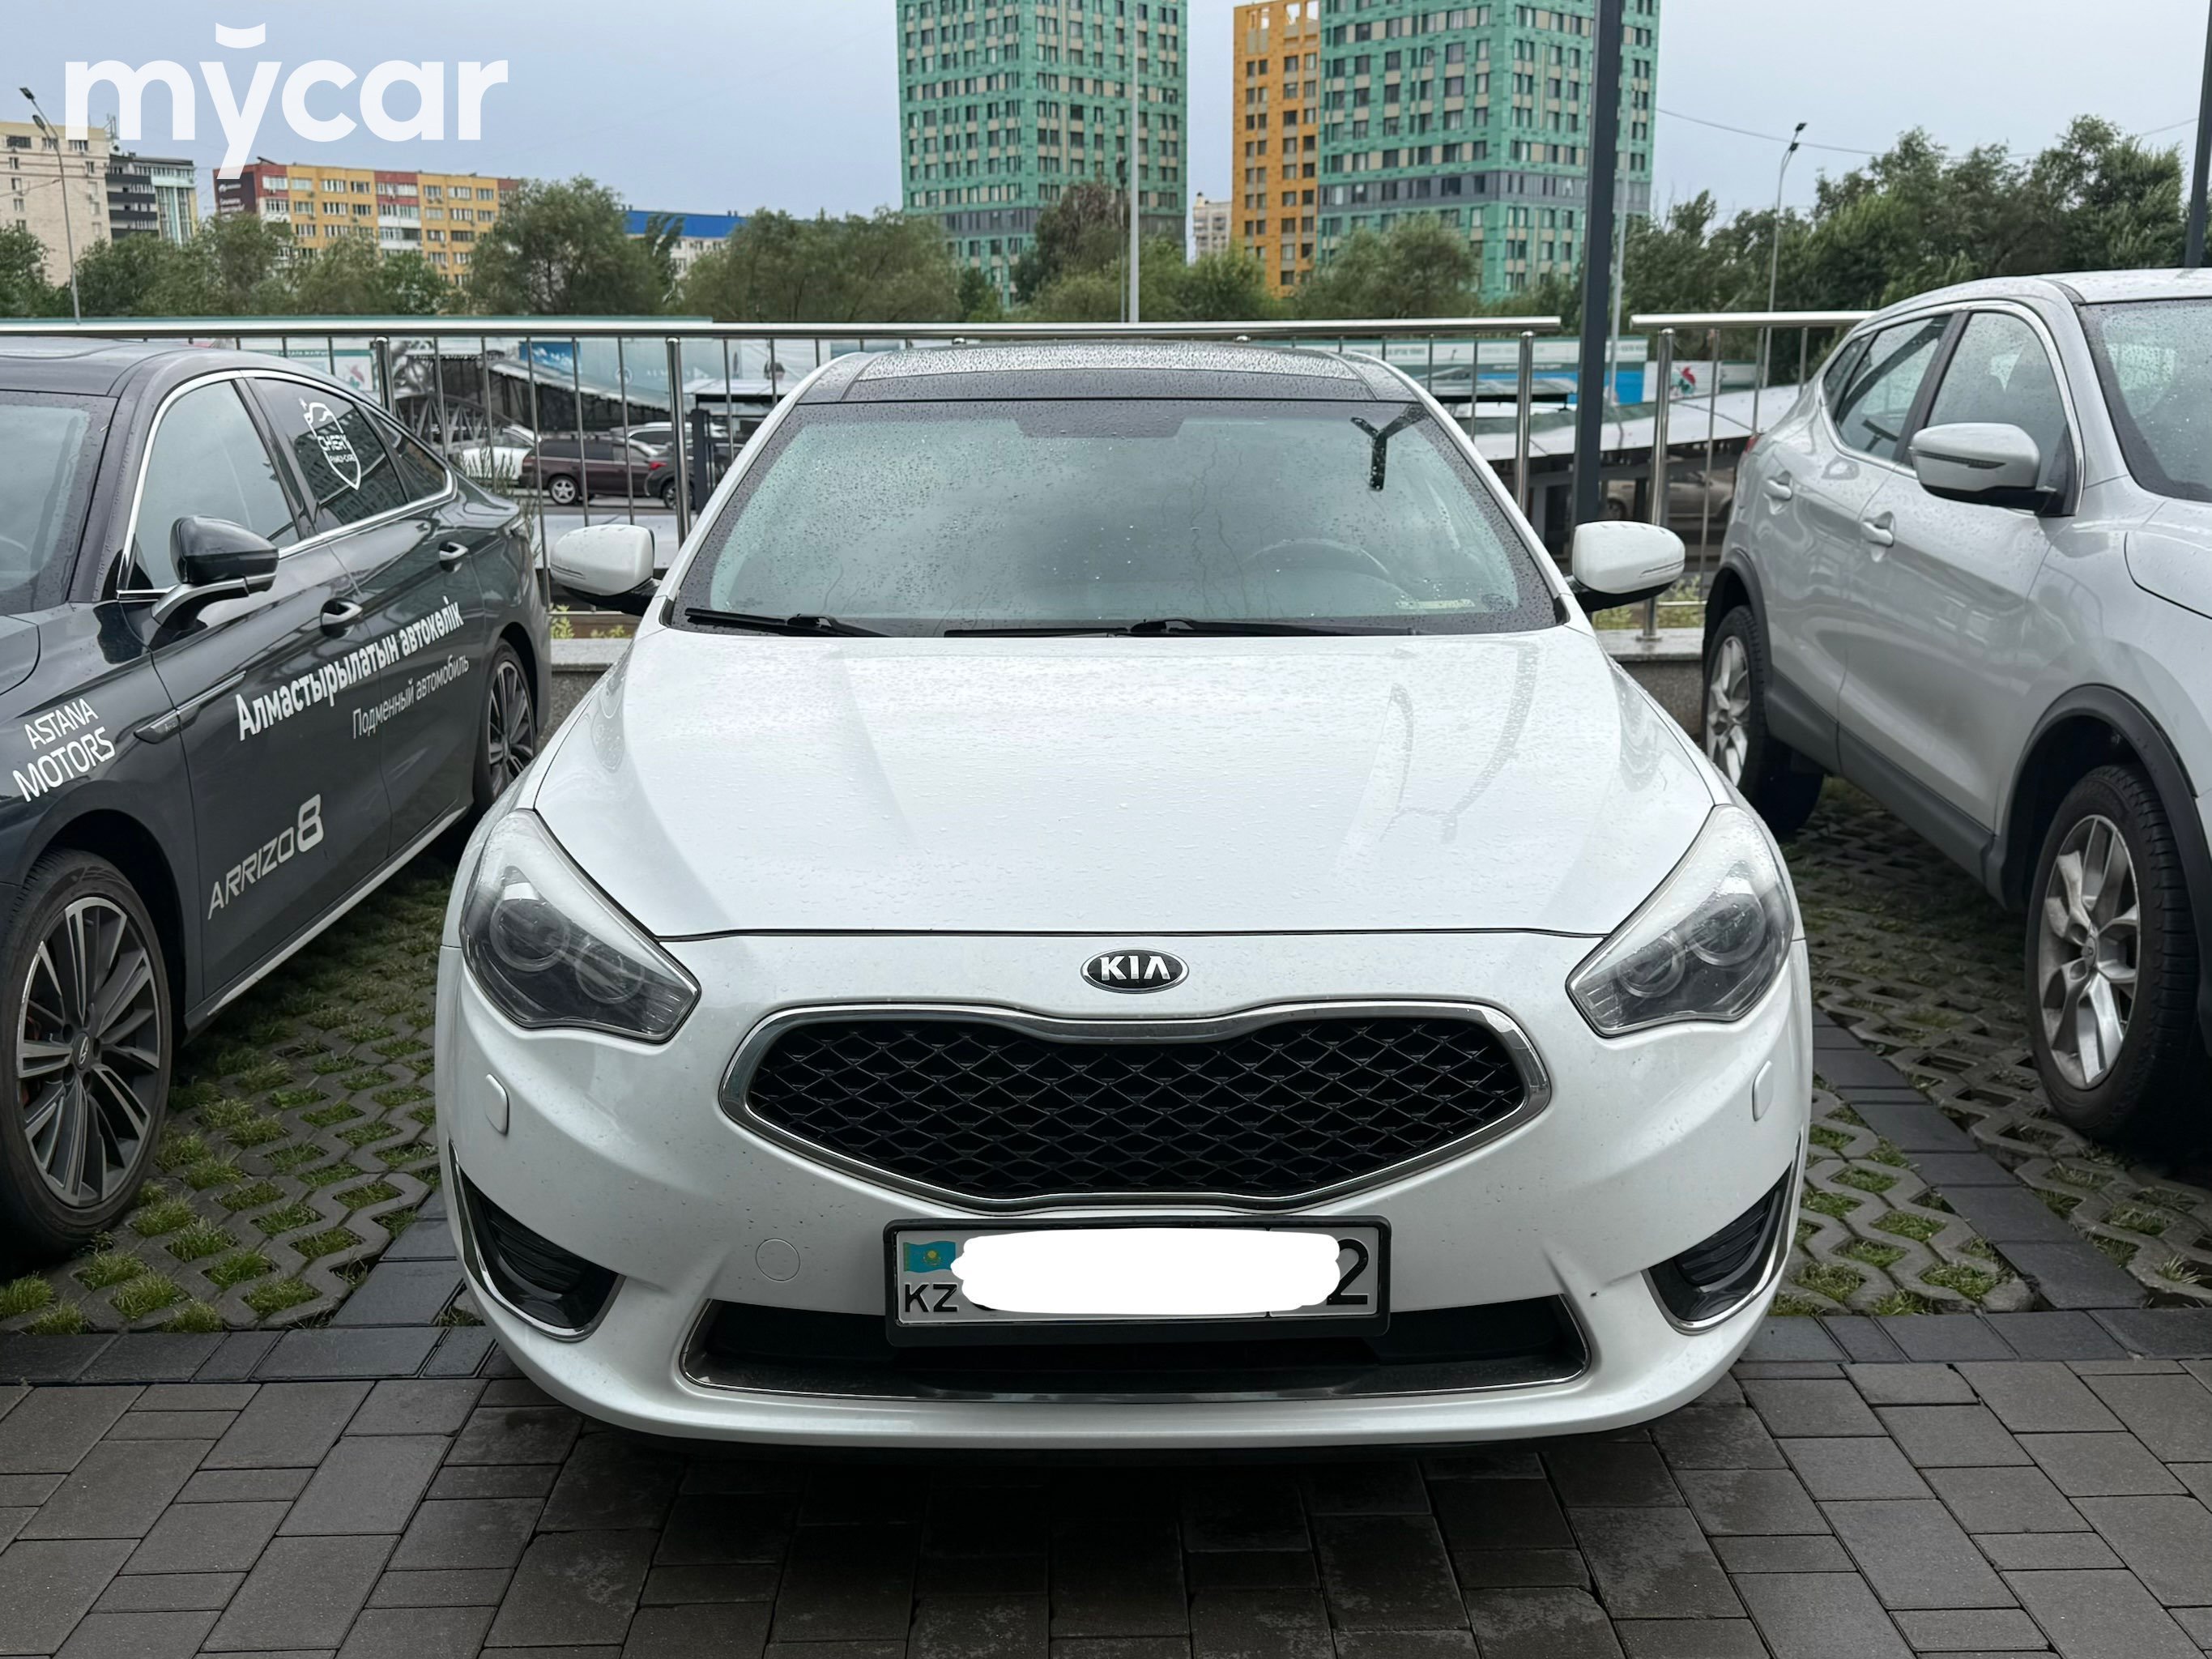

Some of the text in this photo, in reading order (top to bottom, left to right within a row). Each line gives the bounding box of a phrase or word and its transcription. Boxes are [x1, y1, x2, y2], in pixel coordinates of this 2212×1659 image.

[236, 595, 464, 741] Алмастырылатын автокөлік
[352, 654, 470, 740] Подменный автомобиль
[24, 698, 99, 750] ASTANA
[12, 726, 115, 802] MOTORS
[1099, 955, 1171, 981] KIA
[905, 1284, 958, 1312] KZ
